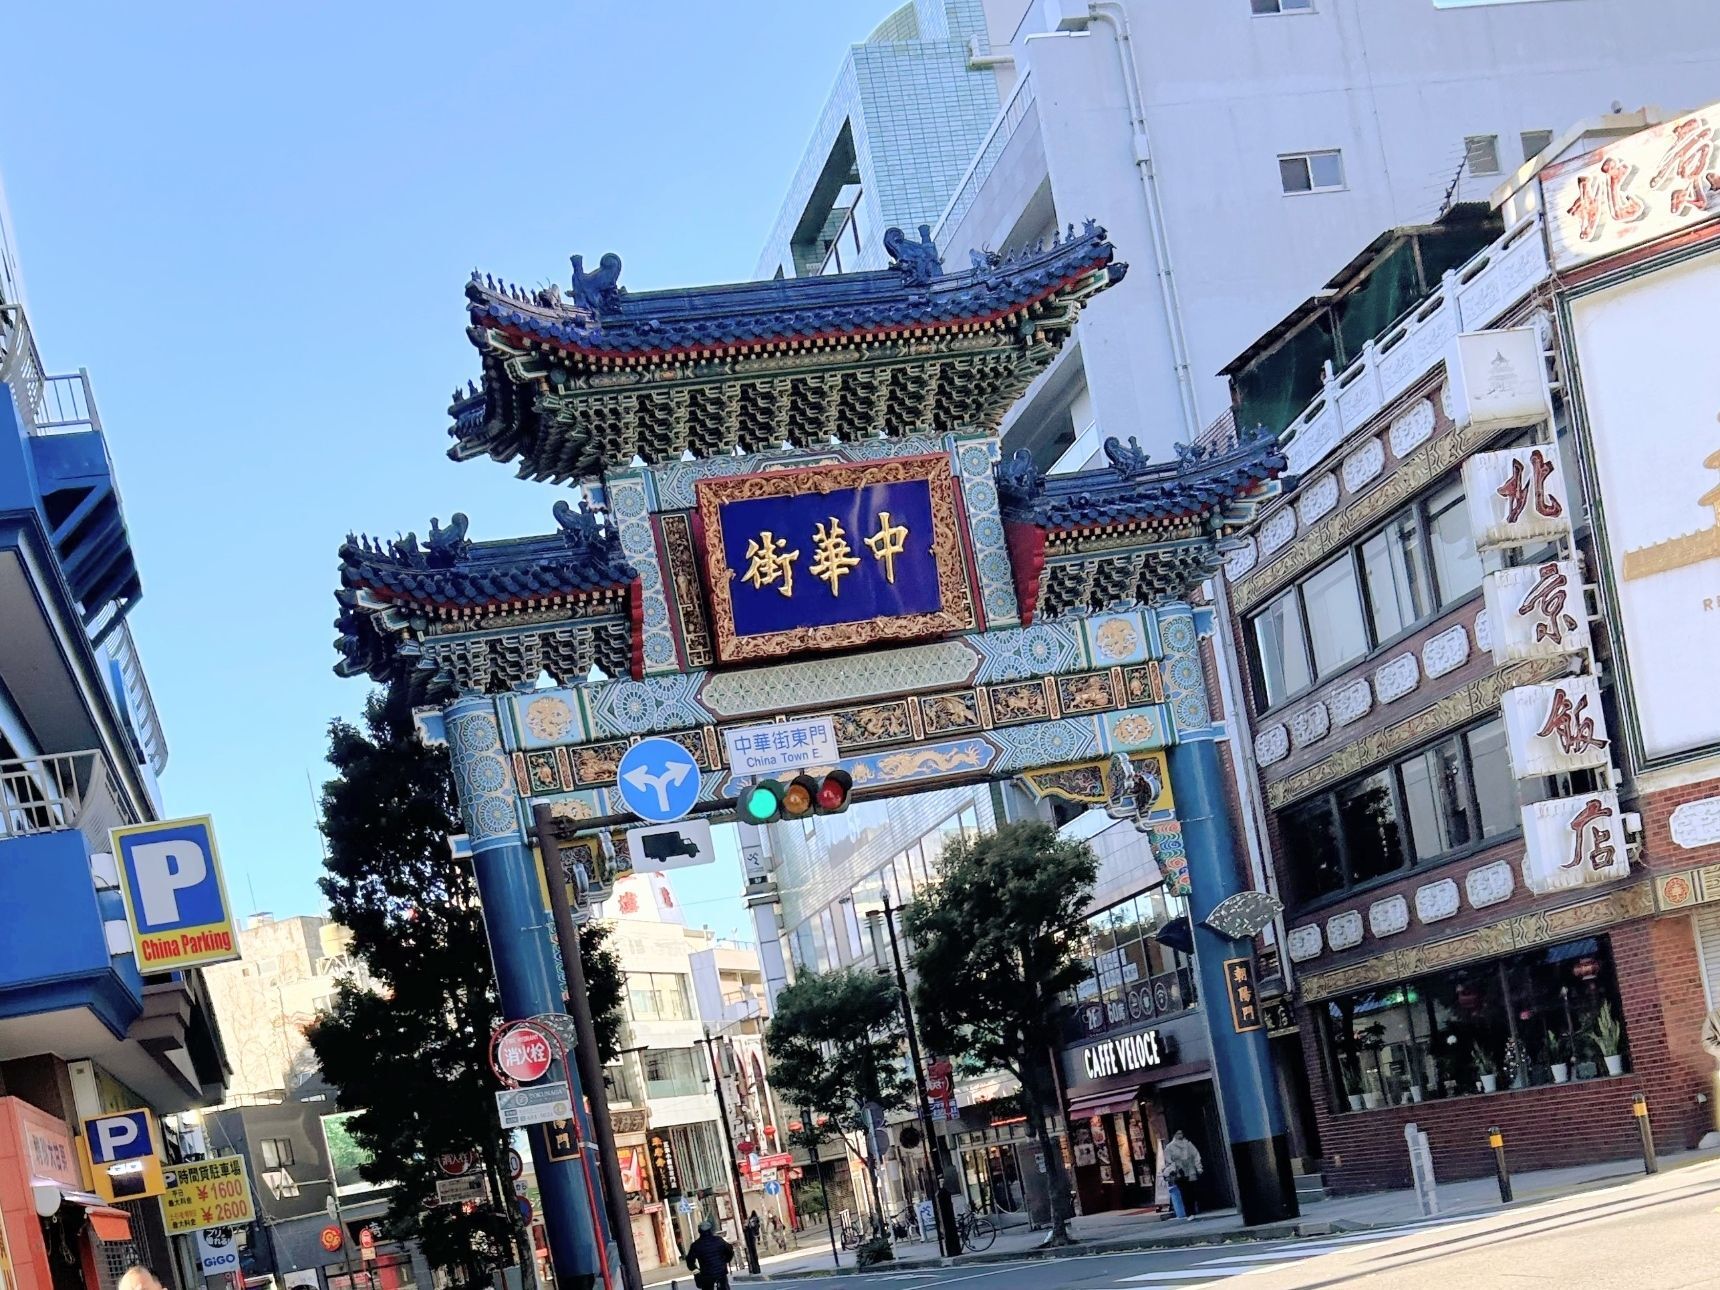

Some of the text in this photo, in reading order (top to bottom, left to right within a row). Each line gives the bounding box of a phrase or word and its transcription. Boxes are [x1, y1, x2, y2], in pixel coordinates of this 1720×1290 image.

[733, 724, 828, 756] 中華街東門
[746, 750, 823, 768] China Town E.
[130, 839, 207, 927] P
[141, 929, 232, 962] China Parking
[504, 1042, 547, 1067] 消火栓
[1115, 1030, 1161, 1072] VELOCE
[95, 1117, 138, 1162] P
[204, 1254, 236, 1267] GiGO
